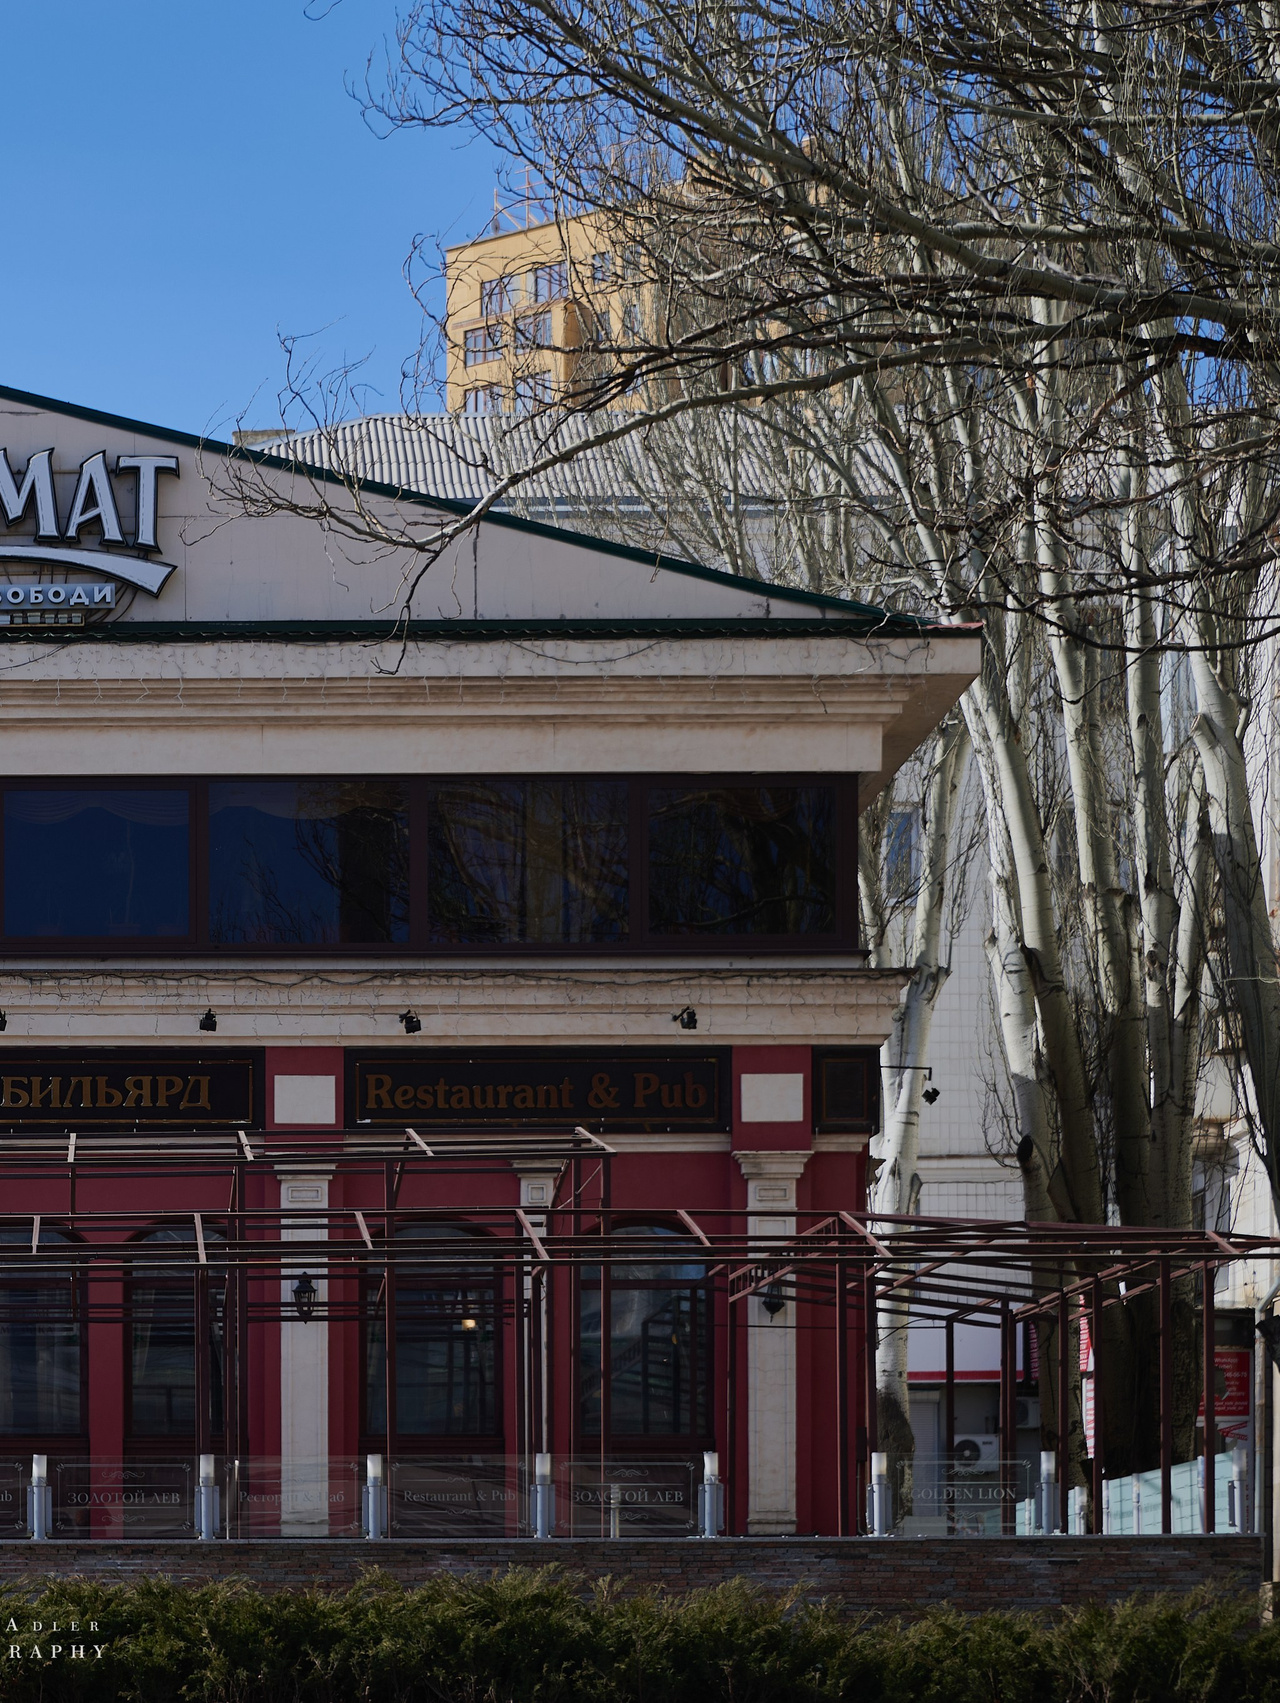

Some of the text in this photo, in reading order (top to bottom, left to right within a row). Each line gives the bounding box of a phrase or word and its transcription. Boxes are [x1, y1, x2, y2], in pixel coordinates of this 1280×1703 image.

[0, 1075, 211, 1110] БИЛЬЯРД
[365, 1071, 708, 1110] Restaurant & Pub
[67, 1489, 181, 1504] ЗОЛОТОЙ ЛЕВ
[403, 1489, 516, 1502] Restaurant & Pub
[652, 1490, 684, 1503] ЛЕВ
[910, 1487, 1017, 1500] GOLDEN LION
